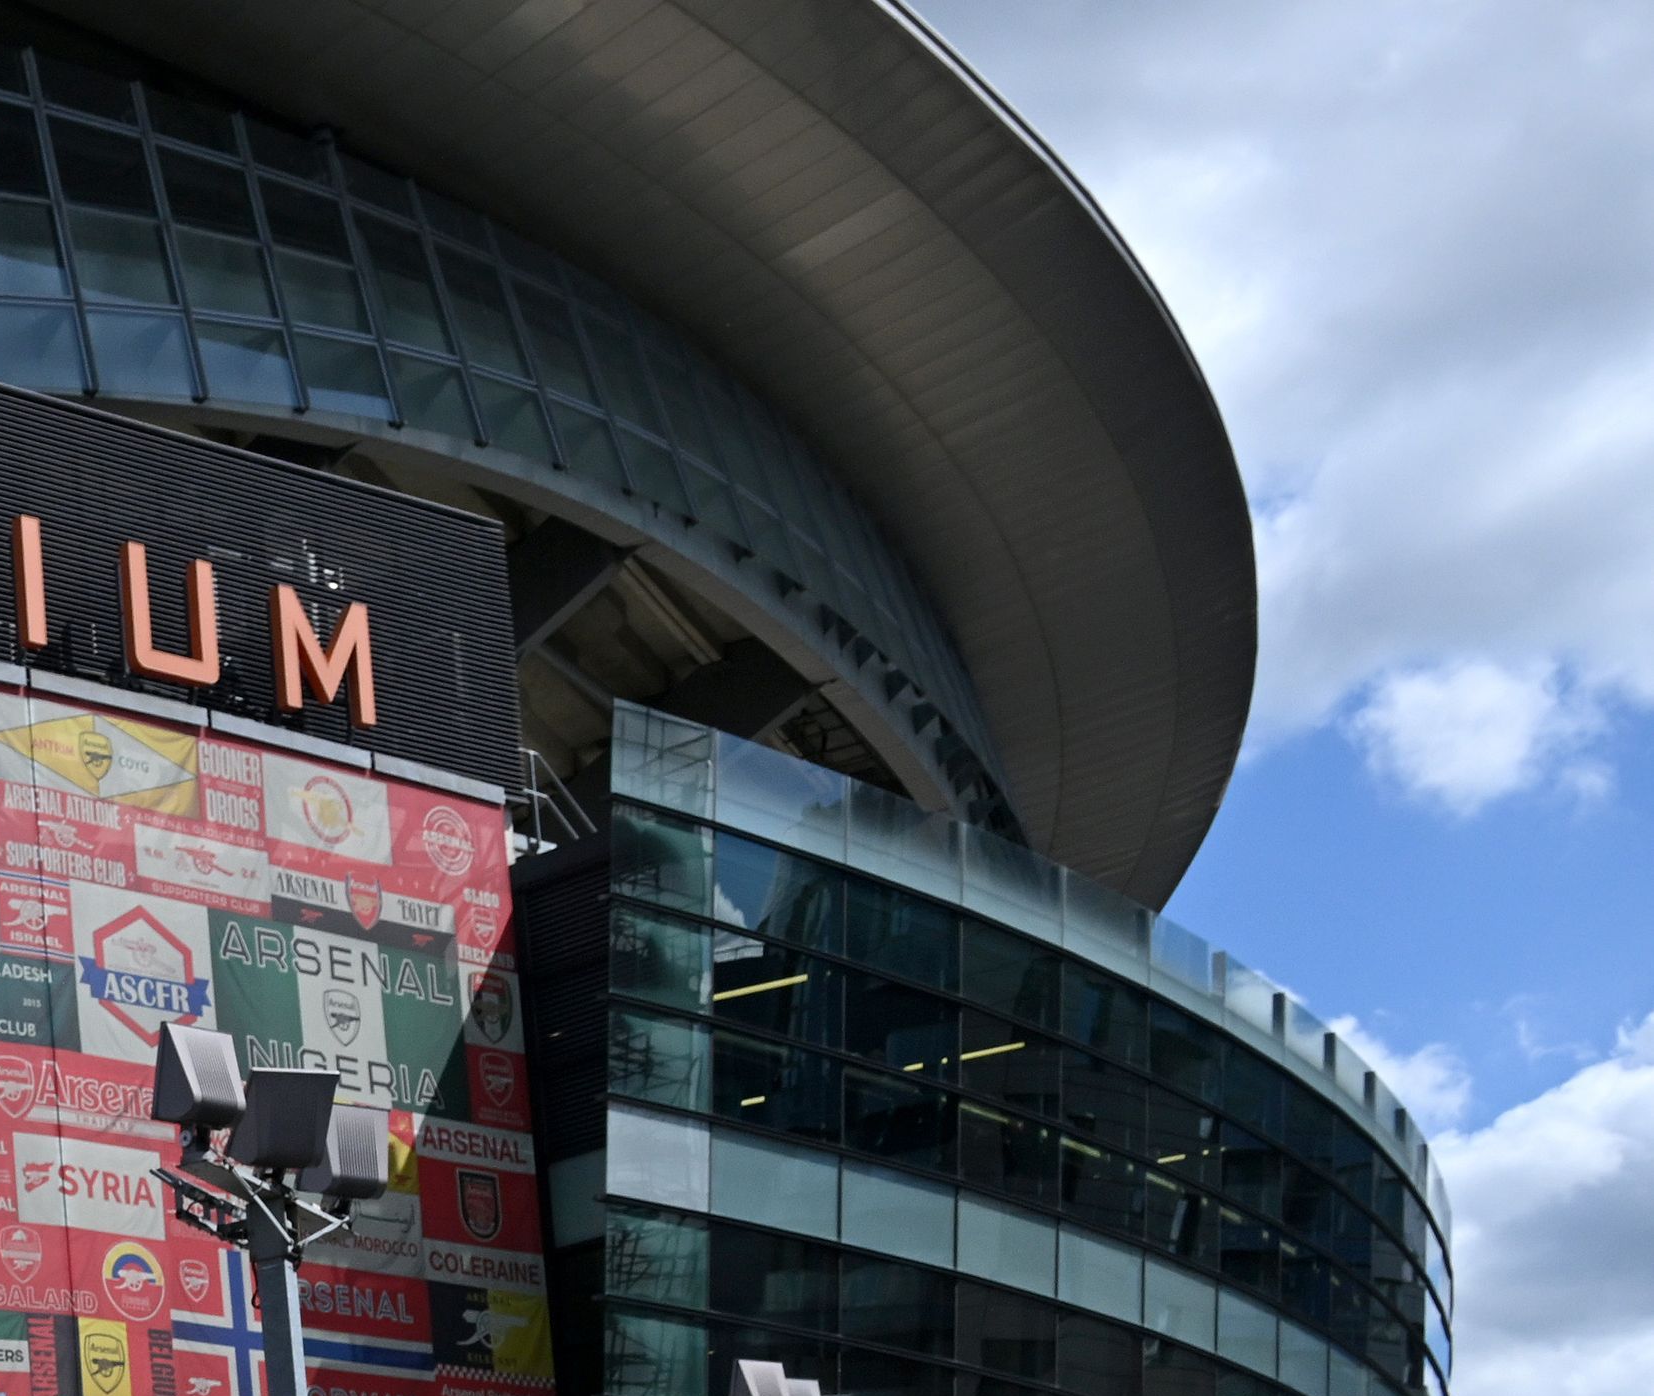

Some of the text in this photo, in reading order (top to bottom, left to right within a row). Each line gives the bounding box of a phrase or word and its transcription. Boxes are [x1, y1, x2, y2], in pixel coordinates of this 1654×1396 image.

[119, 755, 149, 774] COYG
[206, 792, 260, 832] DRUGS
[9, 930, 63, 949] ISRAEL
[104, 973, 189, 1014] ASCFR
[58, 1170, 154, 1209] SYRIA
